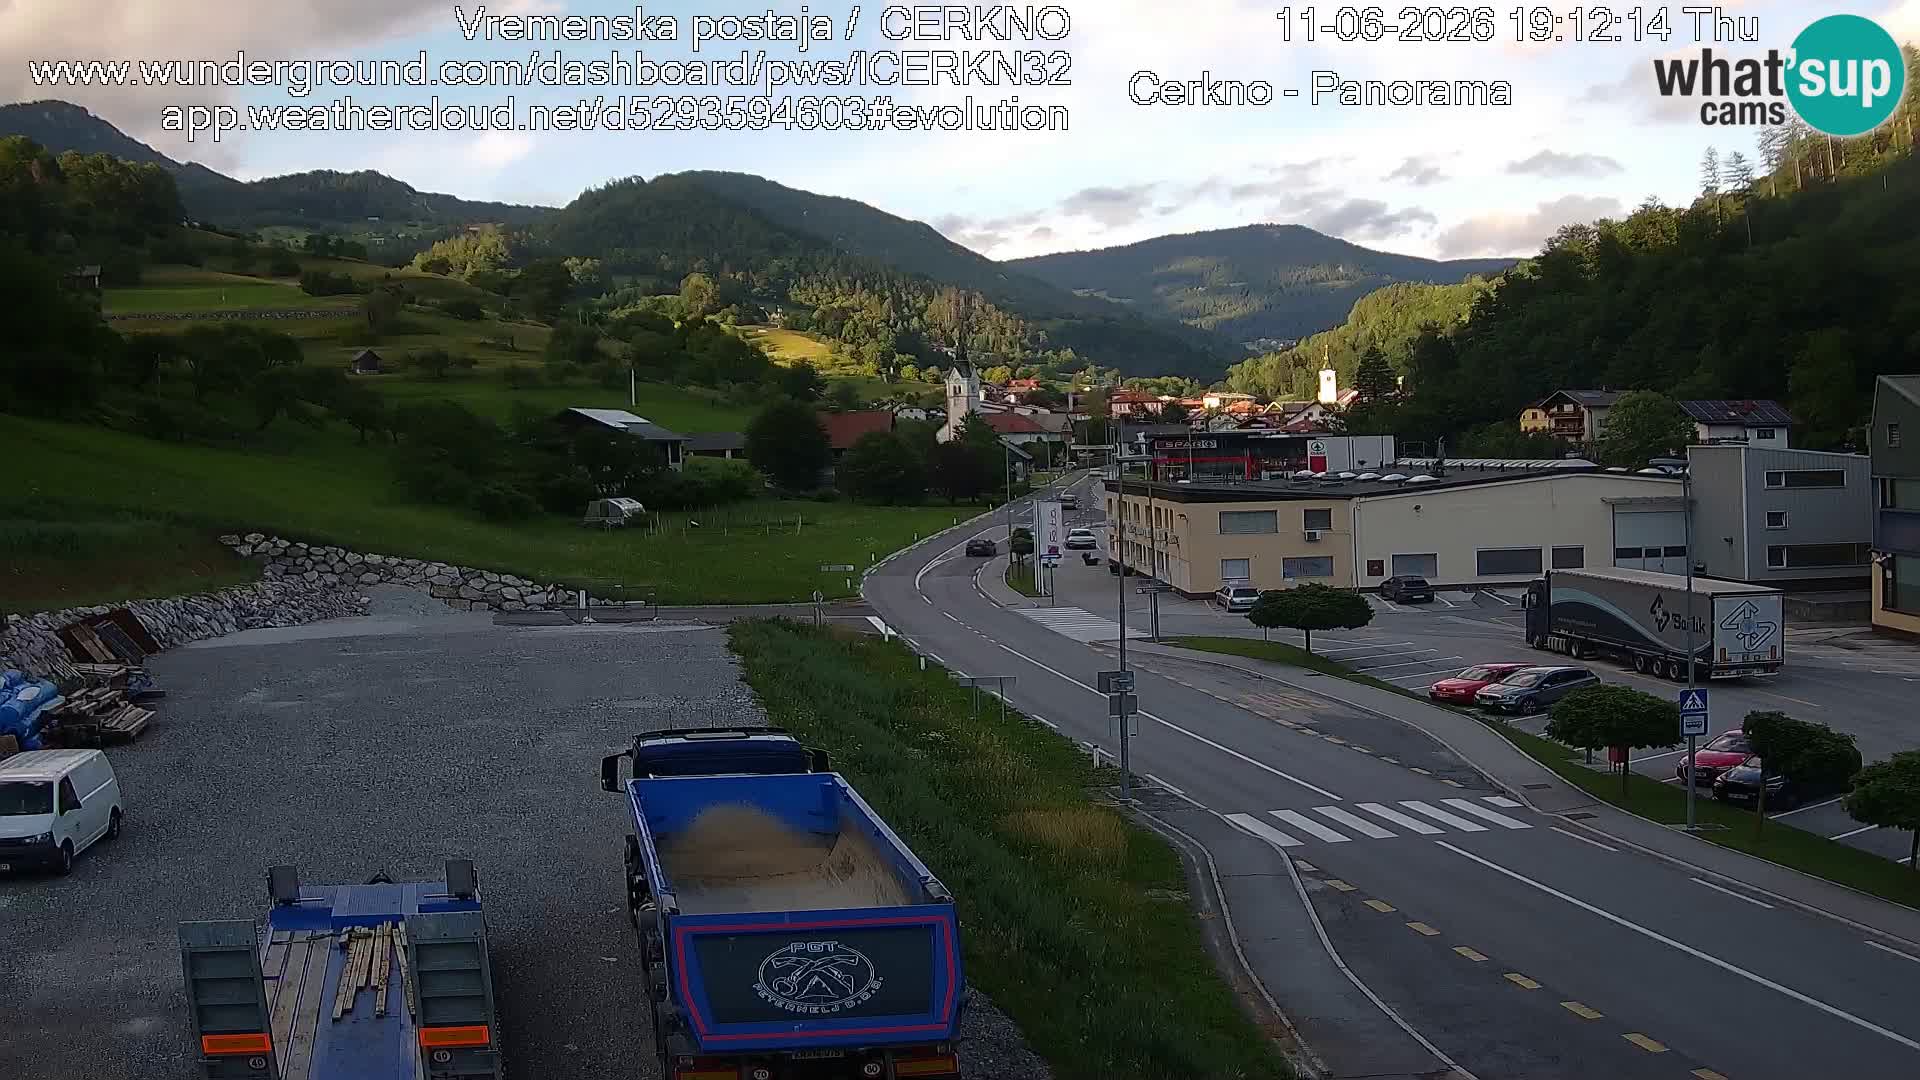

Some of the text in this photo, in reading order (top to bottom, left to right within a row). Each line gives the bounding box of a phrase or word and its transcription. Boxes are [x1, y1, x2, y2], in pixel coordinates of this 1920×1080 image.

[1165, 441, 1202, 449] SPAR
[790, 941, 838, 953] PGT
[251, 1058, 264, 1067] 40
